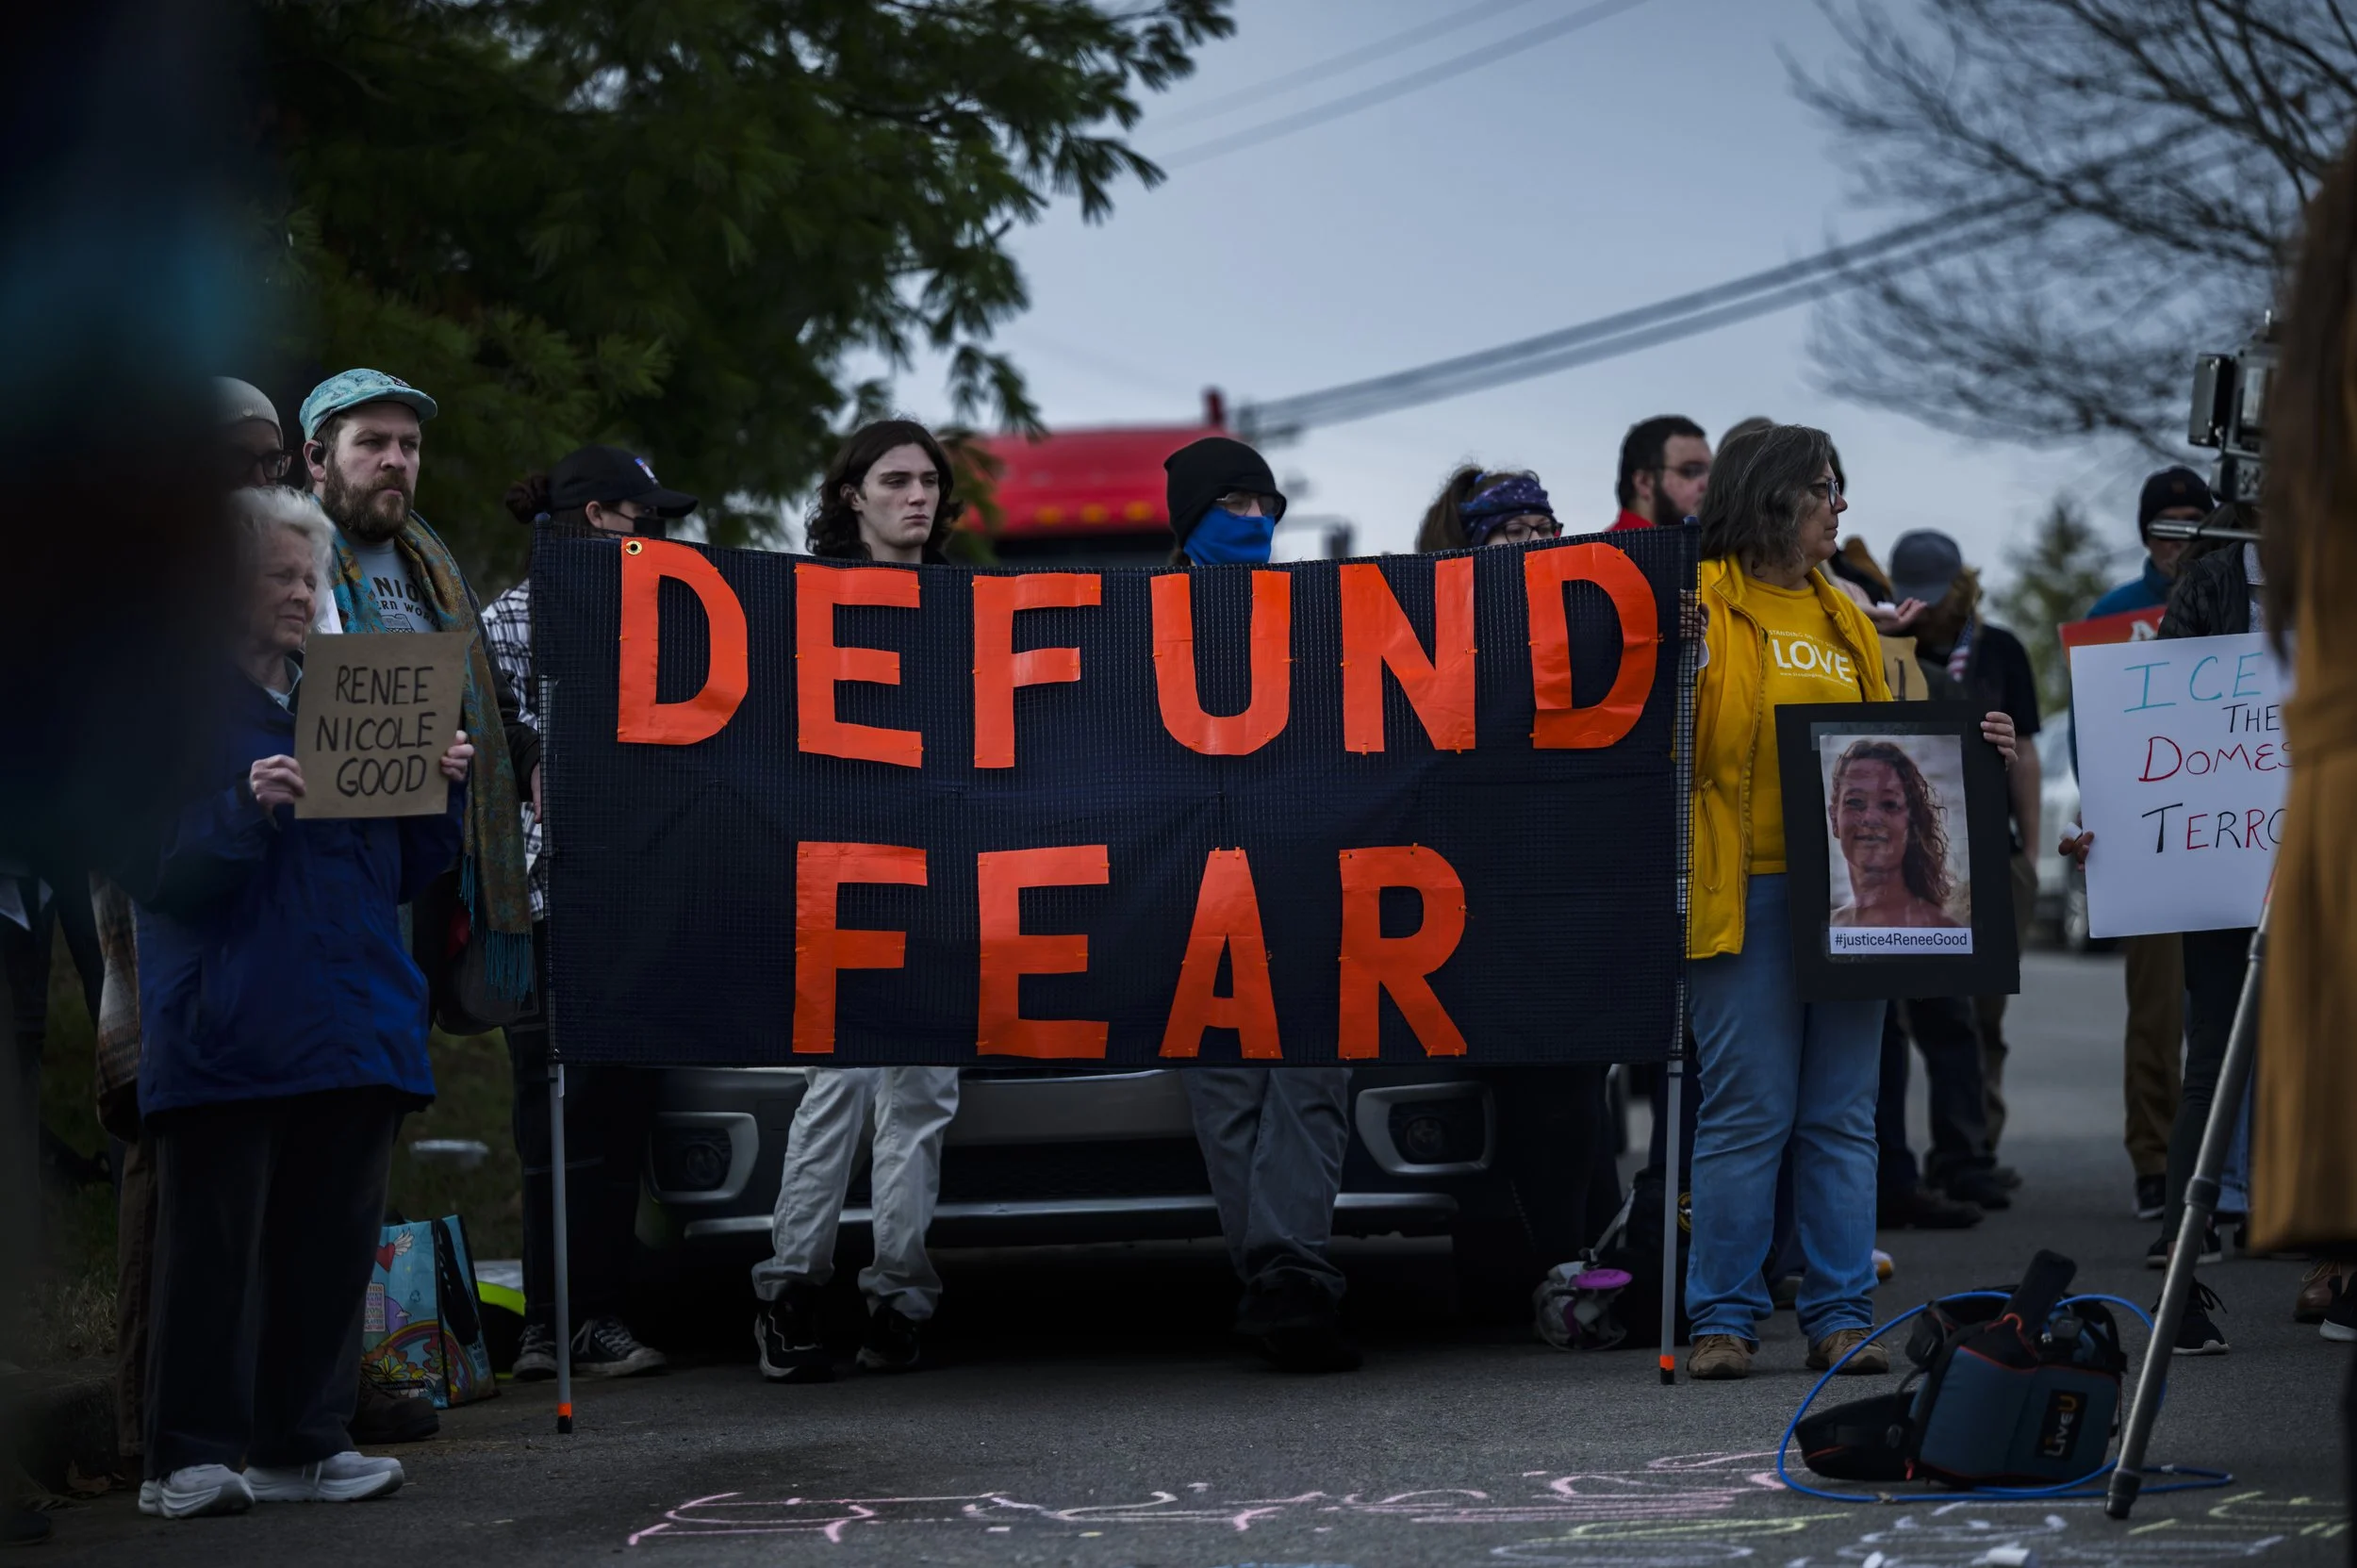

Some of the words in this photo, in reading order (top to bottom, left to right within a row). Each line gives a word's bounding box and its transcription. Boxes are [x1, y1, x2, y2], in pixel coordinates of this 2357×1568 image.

[372, 577, 421, 602] NIO
[618, 536, 1659, 768] DEFUND
[1772, 638, 1854, 684] LOVE
[335, 665, 434, 705] RENEE
[2123, 652, 2264, 713] ICE
[316, 711, 437, 751] NICOLE
[2221, 702, 2281, 734] THE
[336, 754, 427, 798] GOOD
[791, 841, 1467, 1060] FEAR
[1834, 933, 1968, 949] #justice4ReneeGood
